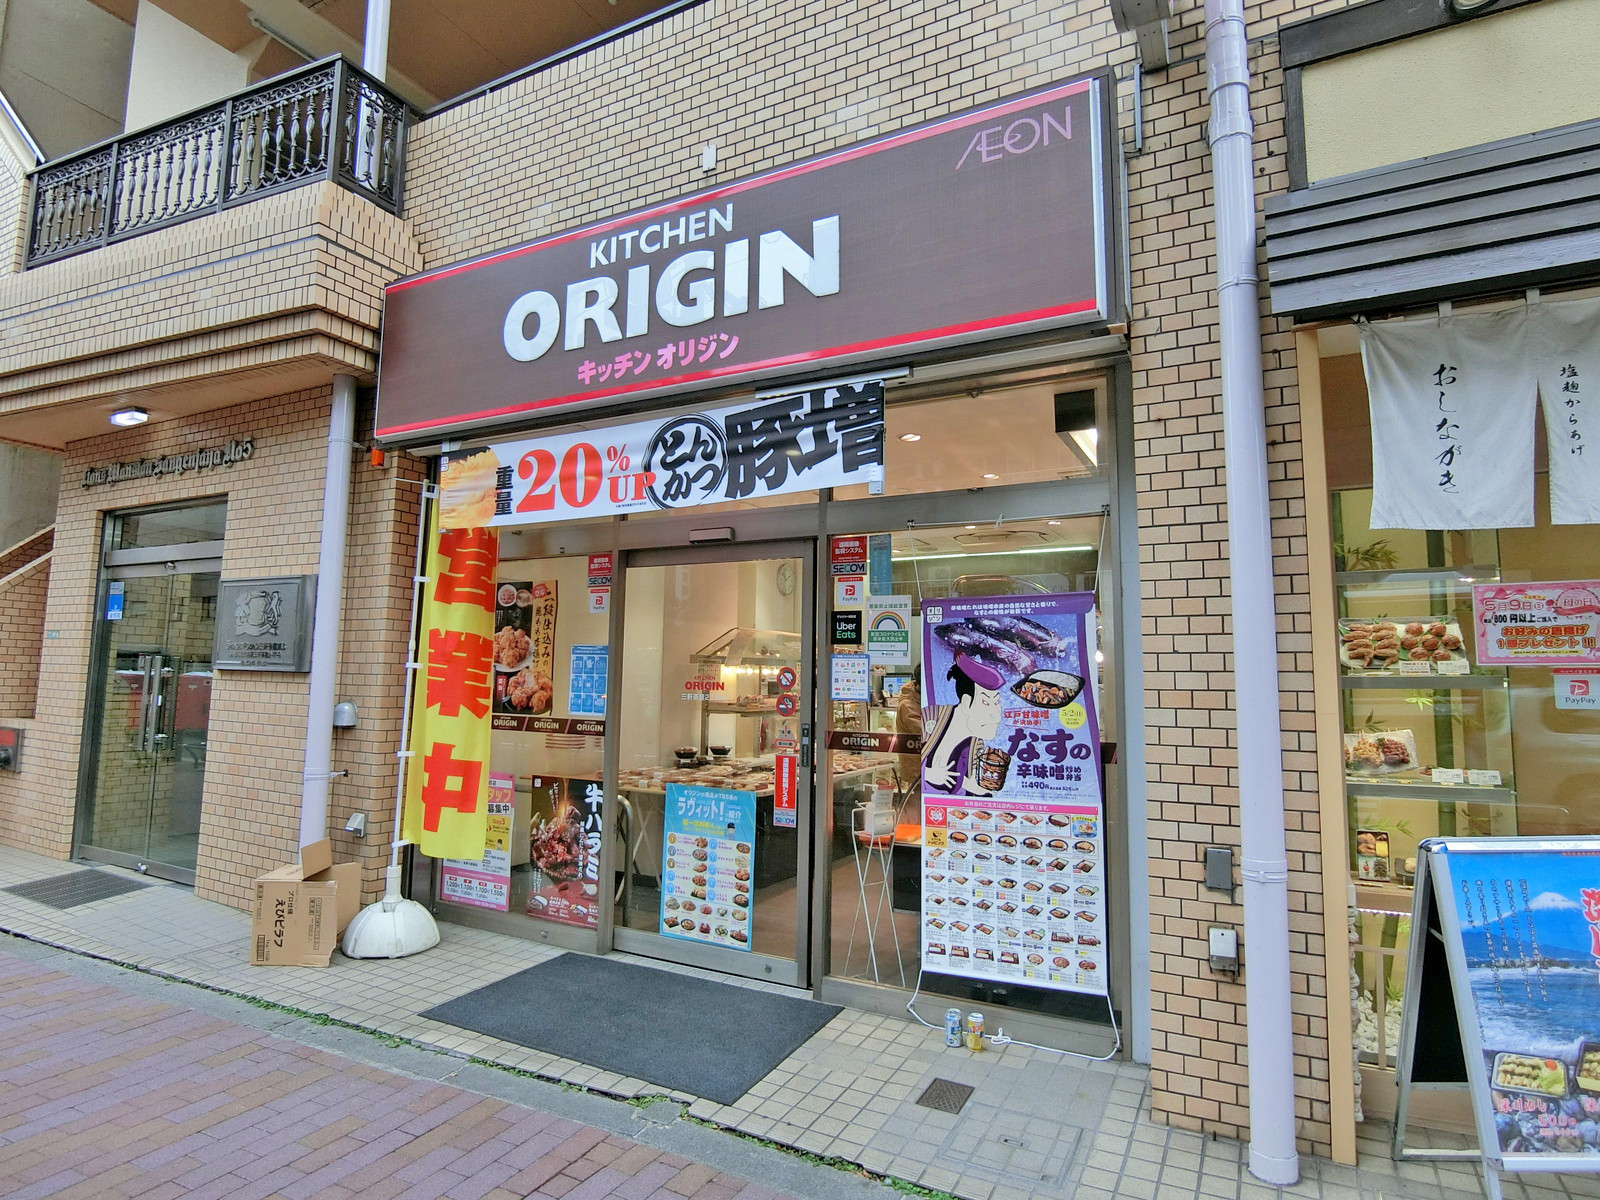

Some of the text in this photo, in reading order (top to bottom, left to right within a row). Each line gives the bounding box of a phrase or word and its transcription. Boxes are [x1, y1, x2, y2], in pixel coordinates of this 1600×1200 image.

[589, 203, 734, 269] KITCHEN
[503, 214, 840, 363] ORIGIN
[1432, 363, 1463, 495] おしながき
[494, 465, 514, 516] 重量
[607, 471, 657, 504] UP
[832, 563, 865, 573] SECOM
[836, 622, 857, 630] Uber
[836, 631, 857, 639] Eats
[421, 527, 499, 832] 営業中
[685, 681, 725, 691] ORIGIN
[1565, 696, 1597, 705] PayPay
[493, 718, 518, 727] ORIGIN
[534, 721, 560, 729] ORIGIN
[576, 723, 604, 732] ORIGIN
[841, 737, 880, 747] ORIGIN
[1007, 728, 1092, 764] なすの
[488, 803, 510, 814] 募集中
[584, 783, 604, 881] 牛ハラミ
[274, 898, 286, 948] えびピラフ
